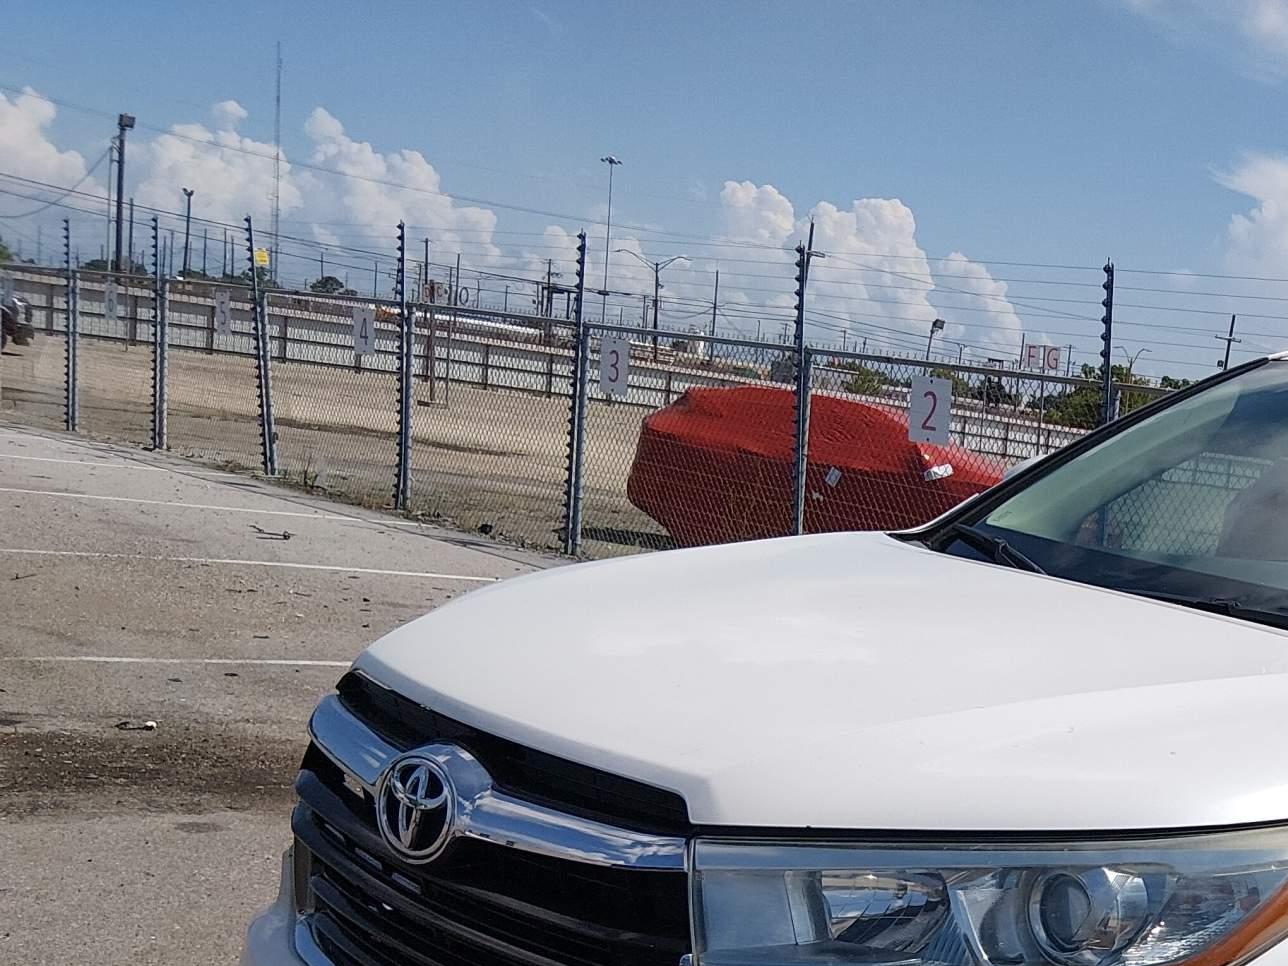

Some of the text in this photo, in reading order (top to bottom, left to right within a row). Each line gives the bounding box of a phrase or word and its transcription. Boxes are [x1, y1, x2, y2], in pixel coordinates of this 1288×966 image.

[219, 300, 227, 325] 5
[360, 318, 369, 345] 4
[608, 350, 619, 383] 3
[1028, 345, 1037, 368] F
[1047, 348, 1058, 369] G
[921, 391, 937, 431] 2
